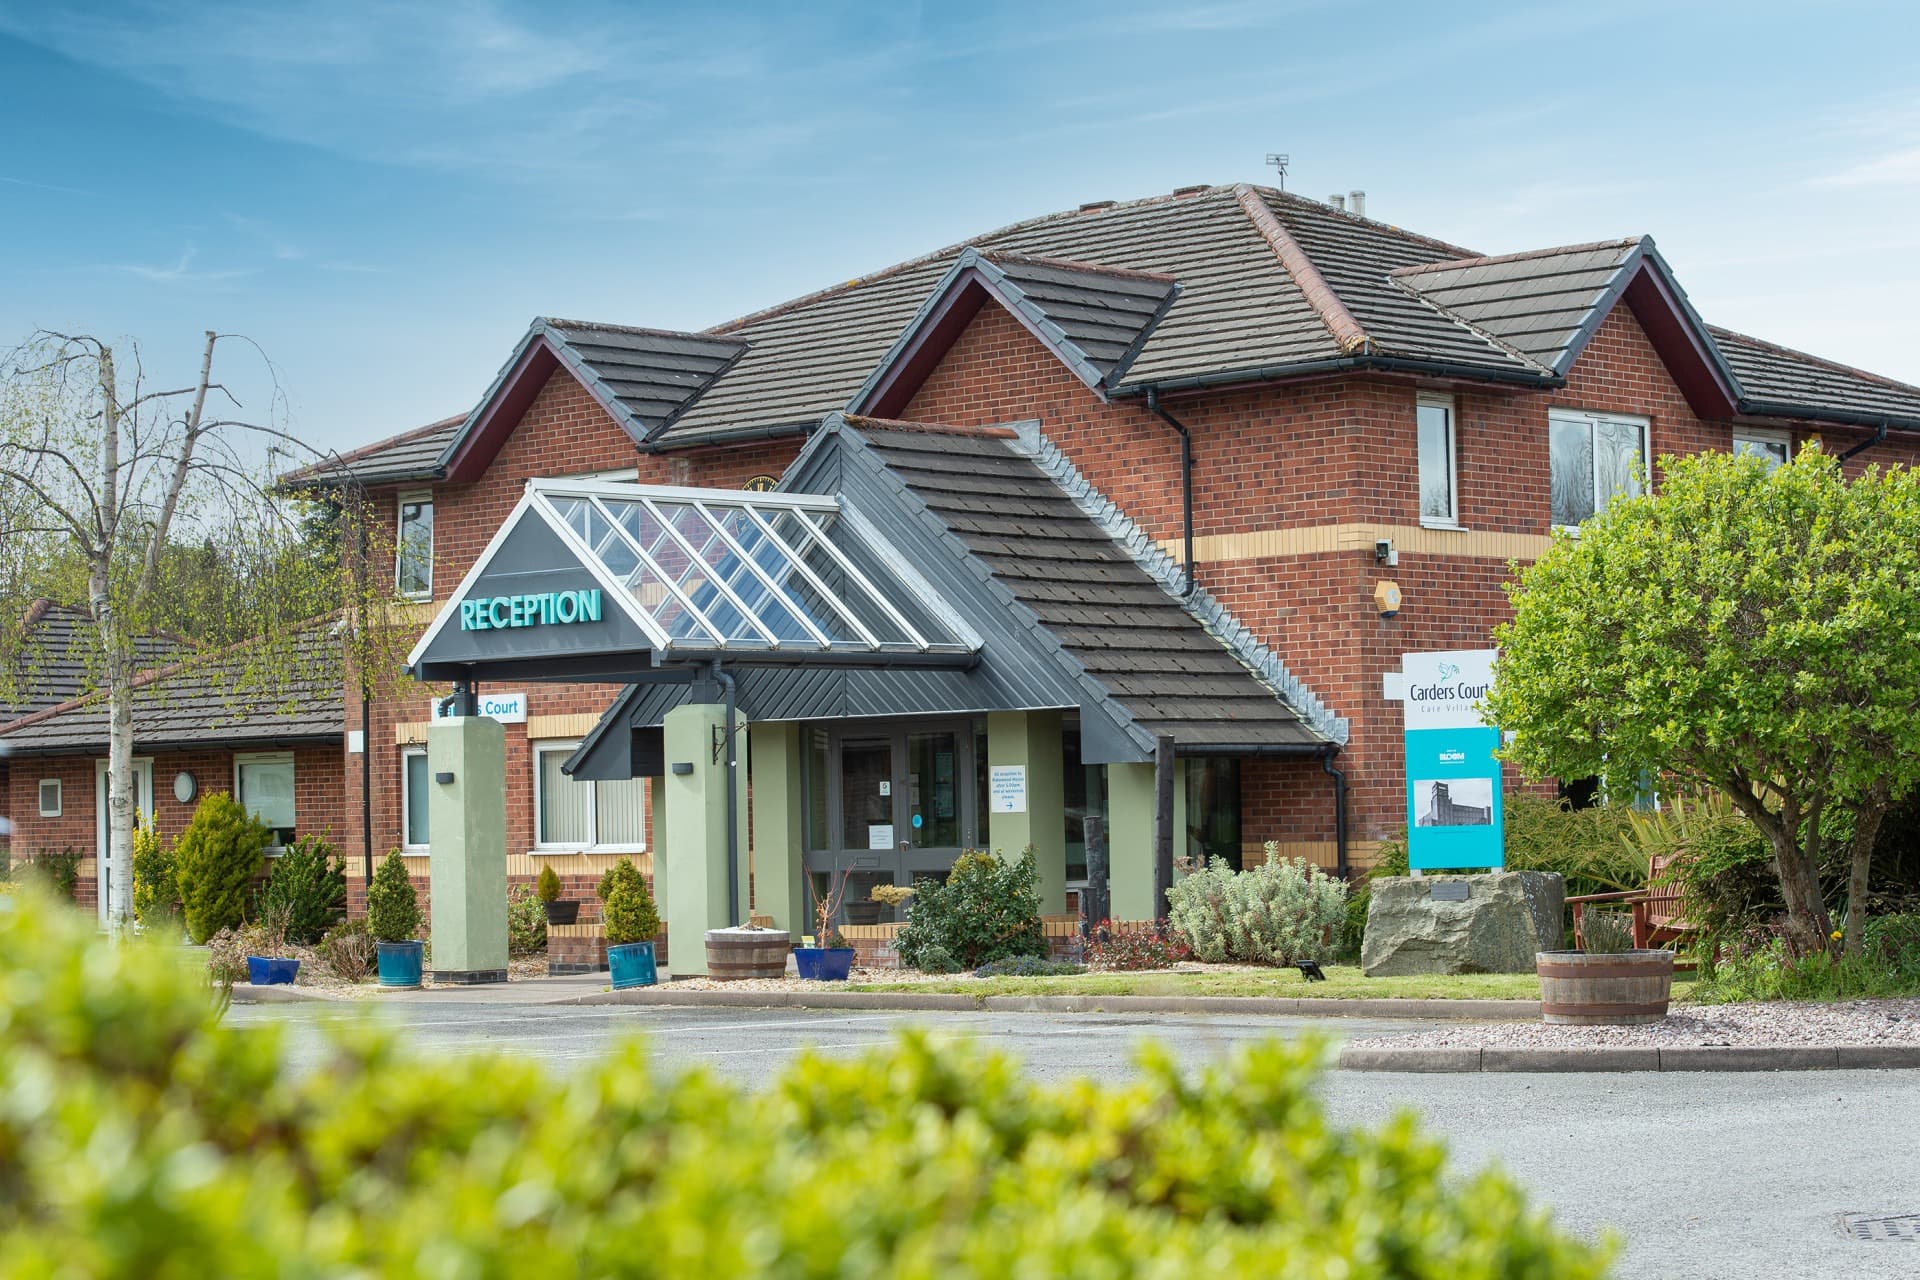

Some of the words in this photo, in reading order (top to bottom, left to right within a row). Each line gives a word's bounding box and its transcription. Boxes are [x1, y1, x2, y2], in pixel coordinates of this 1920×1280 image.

[460, 589, 601, 631] RECEPTION
[1410, 683, 1455, 702] Carders
[1458, 682, 1490, 700] Court
[485, 700, 519, 715] Court
